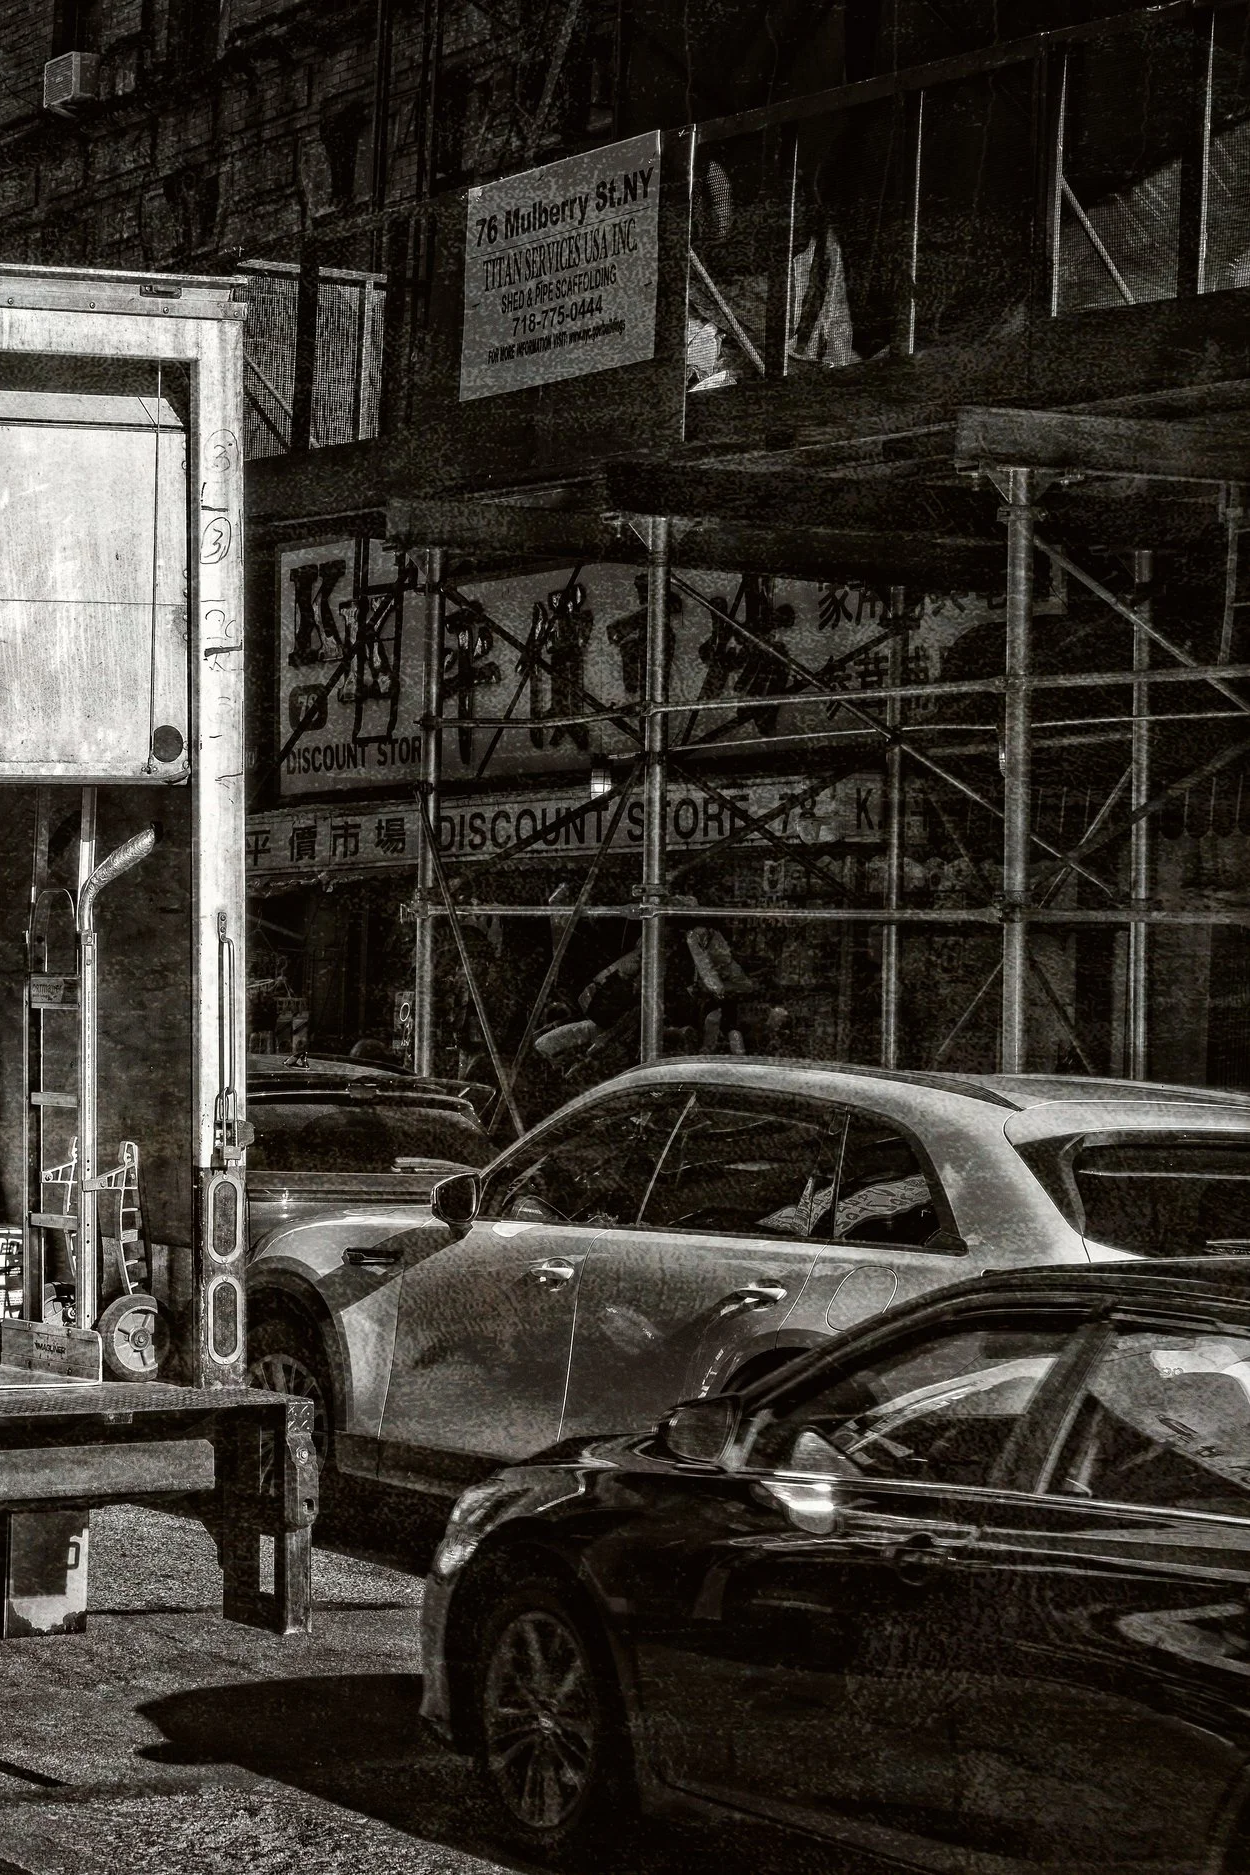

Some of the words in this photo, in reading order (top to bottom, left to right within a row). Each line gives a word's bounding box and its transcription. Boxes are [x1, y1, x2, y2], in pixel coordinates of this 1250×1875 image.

[475, 214, 498, 247] 76
[504, 193, 590, 240] Mulberry
[595, 166, 654, 212] St.NY
[483, 250, 523, 291] TITAN
[525, 233, 581, 281] SERVICES
[584, 226, 608, 264] USA
[501, 290, 525, 314] SHED
[527, 288, 532, 308] &
[535, 281, 553, 305] PIPE
[555, 264, 617, 299] SCAFFOLDING
[513, 295, 603, 337] 718-775-0444
[288, 559, 346, 667] K
[286, 743, 368, 775] DISCOUNT
[376, 736, 423, 767] STOR
[247, 816, 407, 866] 平價市場
[436, 801, 611, 851] DISCOUNT
